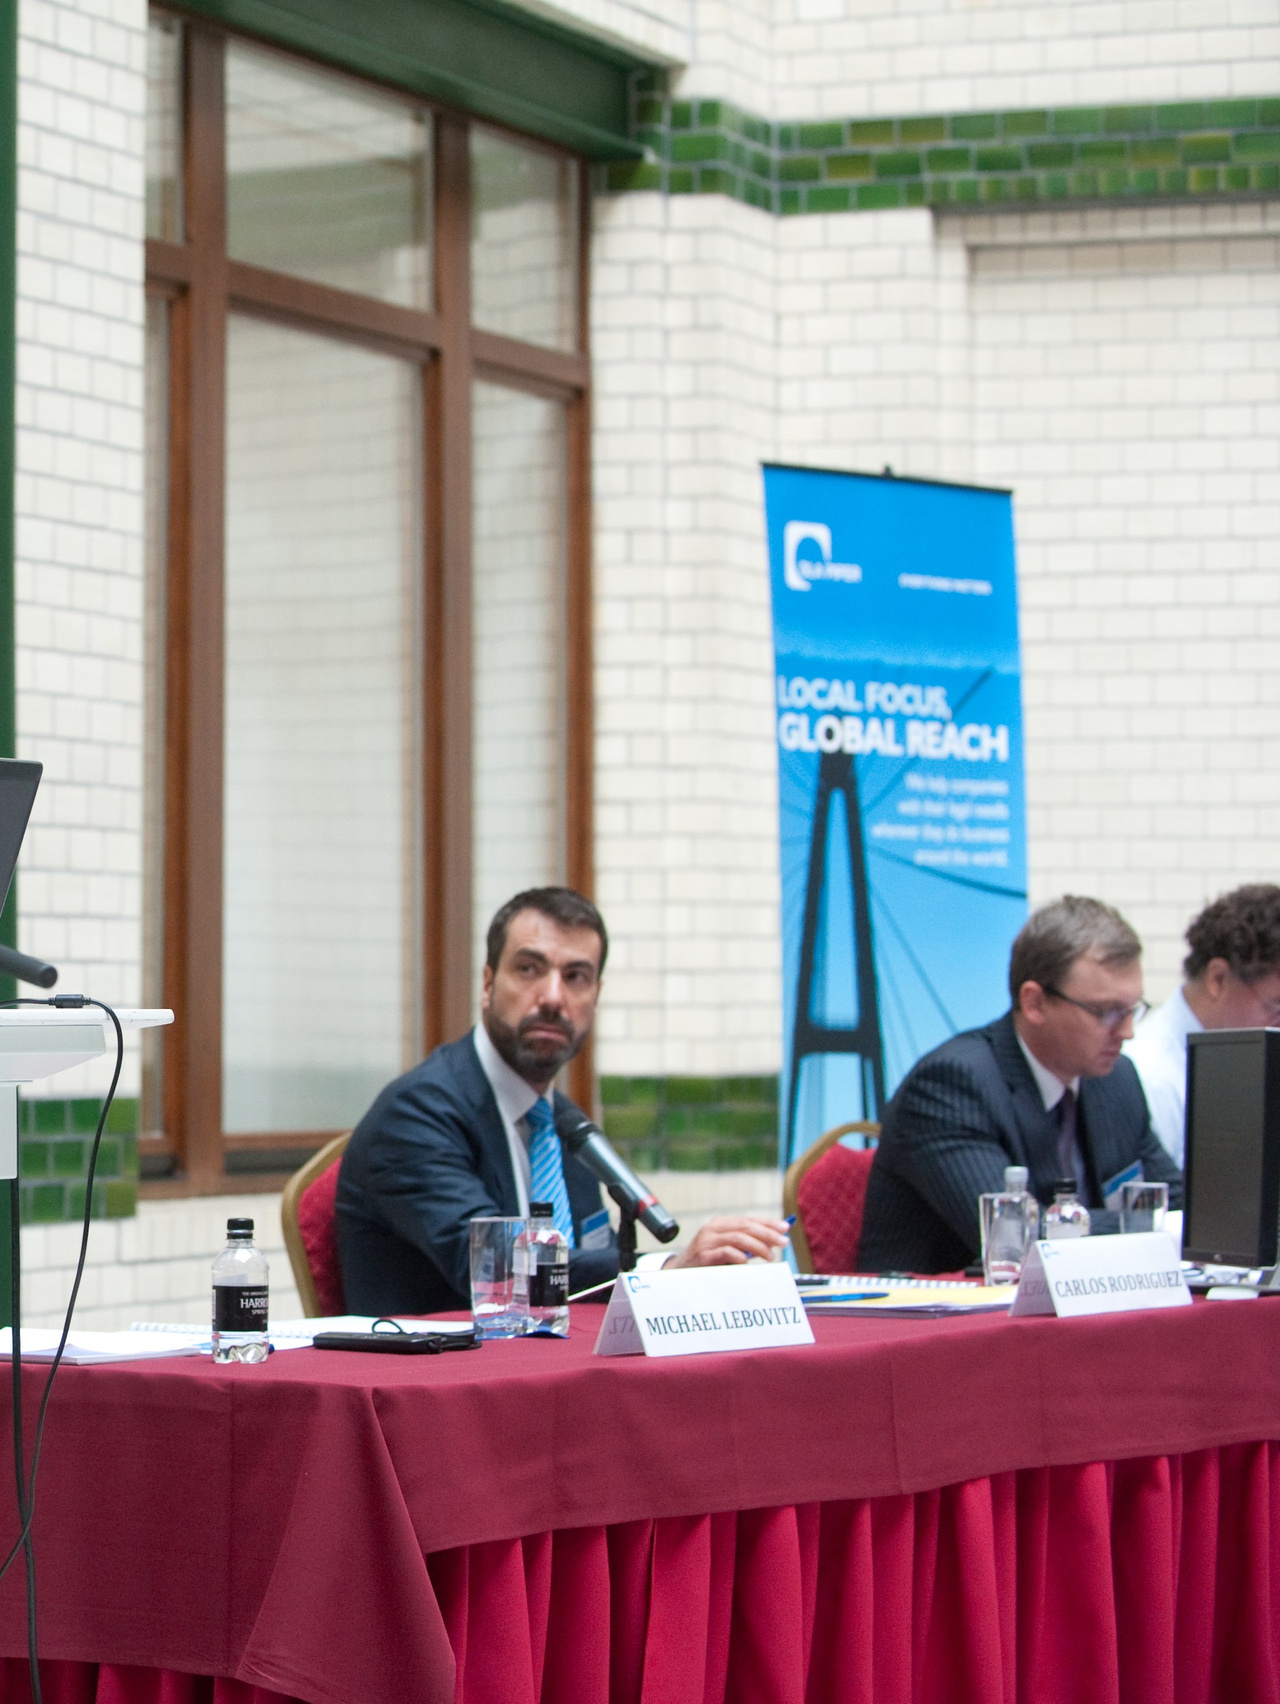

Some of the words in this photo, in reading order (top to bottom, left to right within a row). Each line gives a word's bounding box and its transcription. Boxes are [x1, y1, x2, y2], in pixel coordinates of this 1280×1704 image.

[777, 675, 863, 712] LOCAL
[779, 713, 904, 756] GLOBAL
[907, 720, 1009, 762] REACH
[1055, 1277, 1108, 1298] CARLOS
[1108, 1271, 1182, 1293] RODRIGUEZ
[645, 1313, 721, 1336] MICHAEL
[722, 1306, 802, 1330] LEBOVITZ
